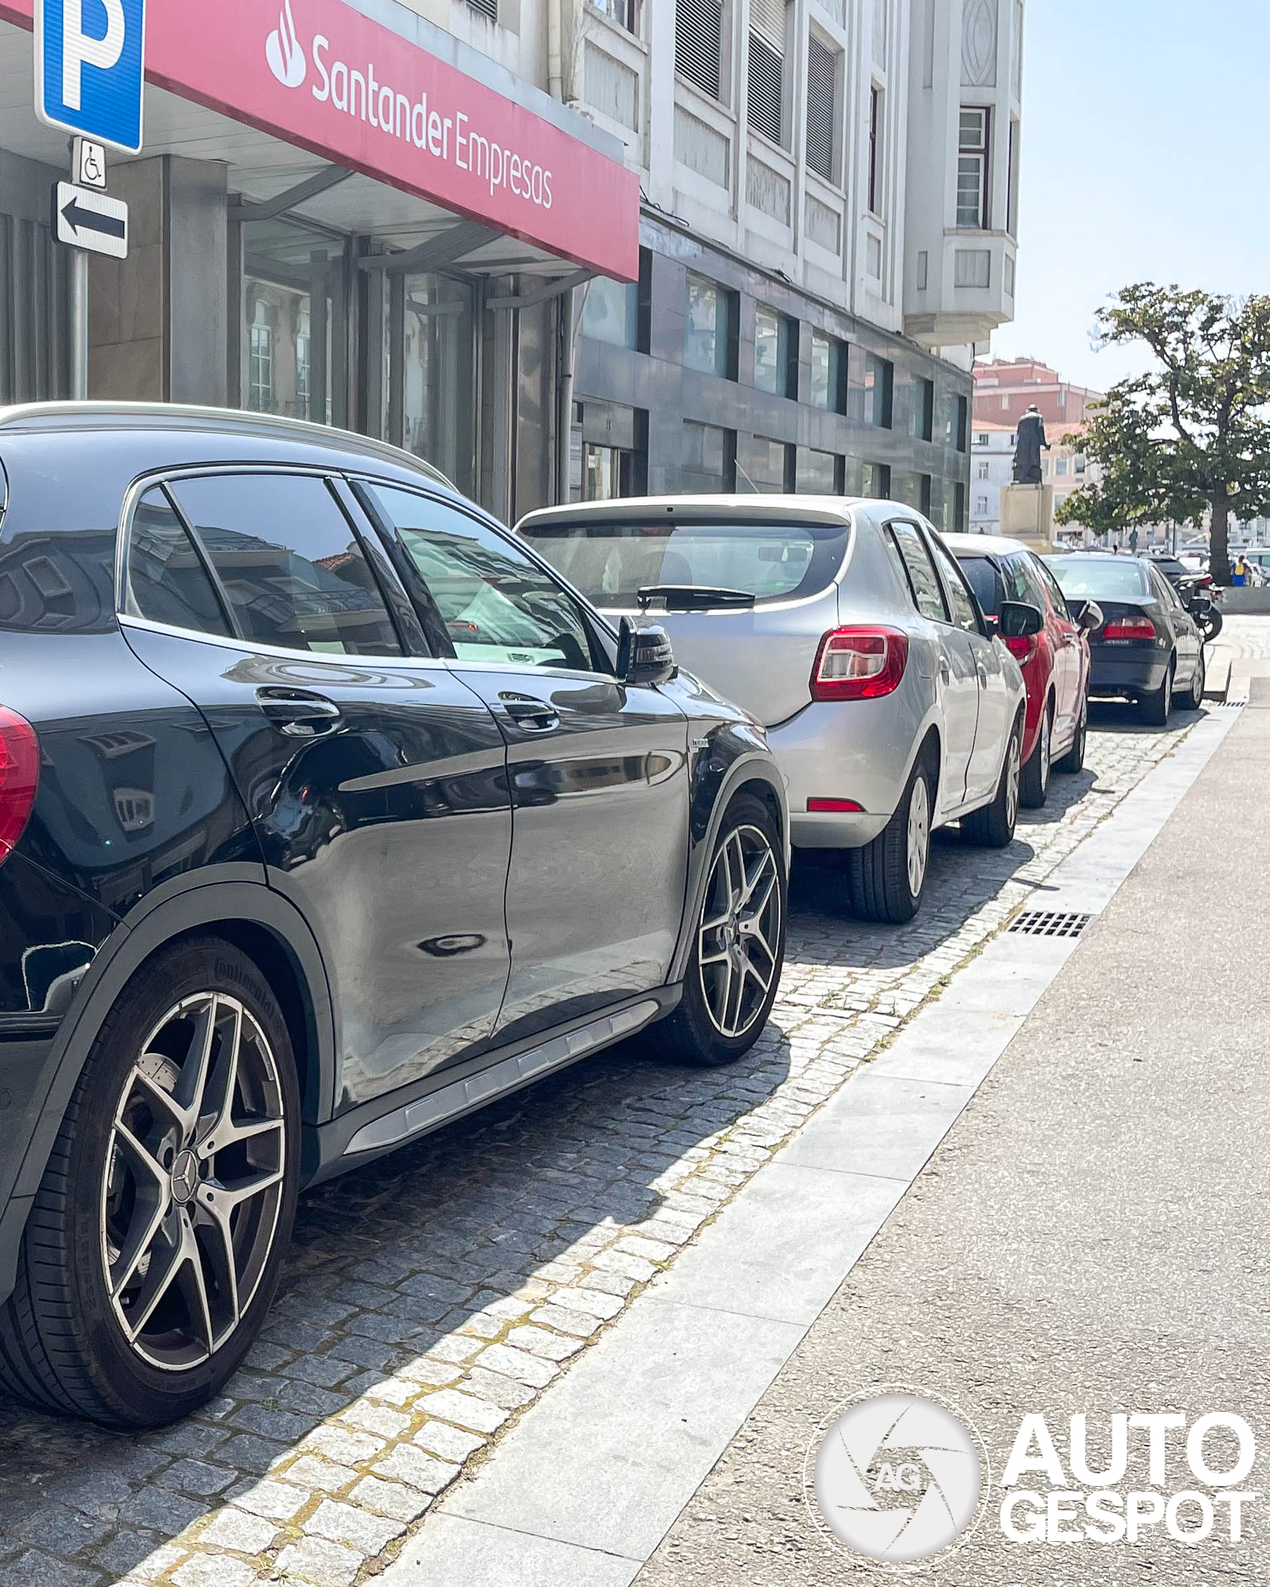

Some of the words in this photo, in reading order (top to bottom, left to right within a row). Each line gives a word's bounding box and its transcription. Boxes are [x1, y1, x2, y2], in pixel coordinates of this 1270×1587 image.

[61, 0, 126, 111] P
[311, 33, 452, 161] Santander
[455, 112, 555, 211] Empresas
